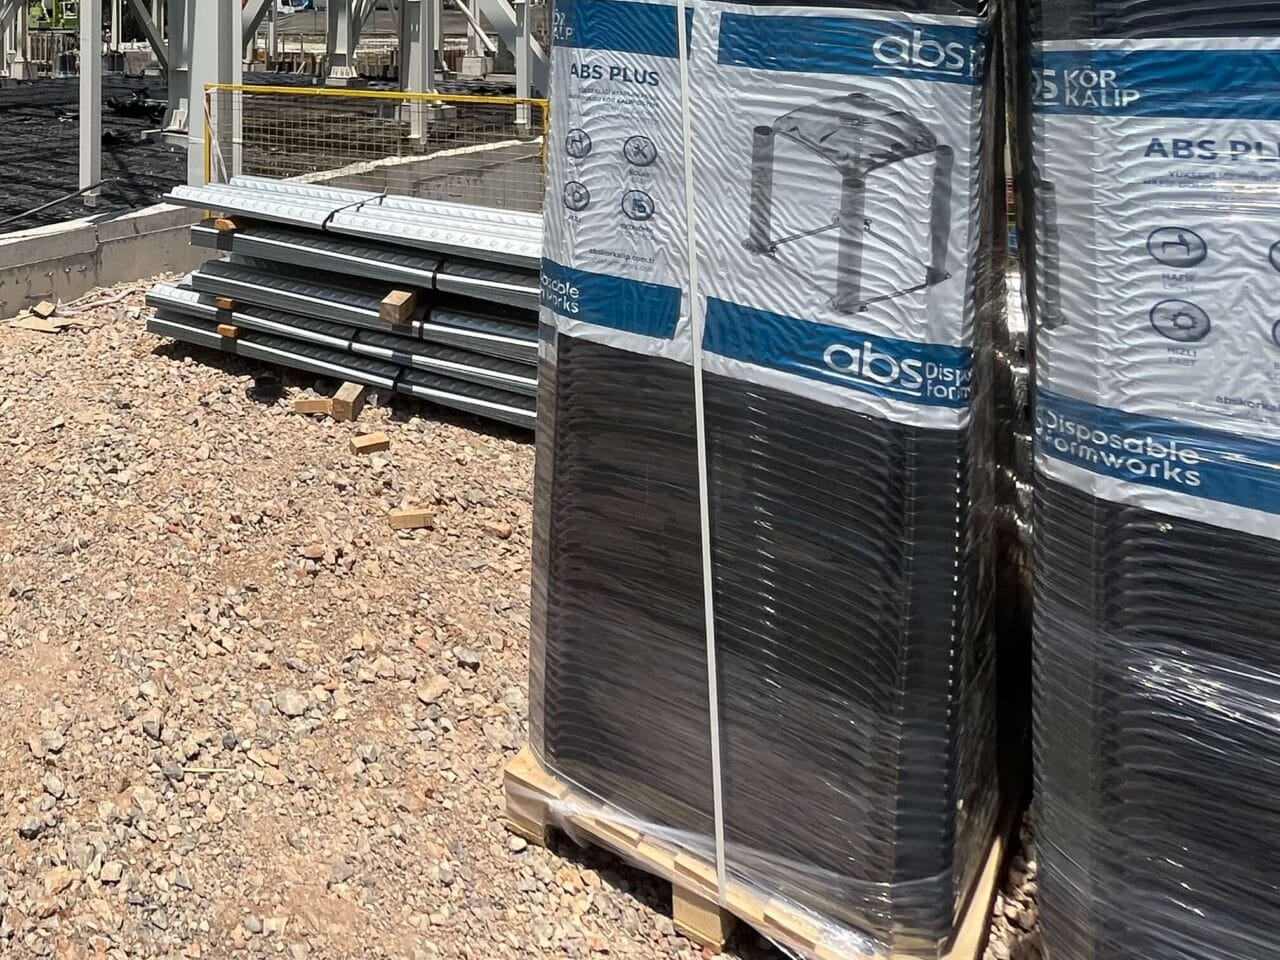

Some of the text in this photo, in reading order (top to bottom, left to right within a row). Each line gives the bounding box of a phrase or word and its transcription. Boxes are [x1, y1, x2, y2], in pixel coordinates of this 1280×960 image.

[872, 29, 964, 70] abs
[570, 63, 660, 87] ABS PLUS
[1063, 65, 1118, 88] KÖR
[1144, 137, 1218, 160] ABS
[822, 341, 923, 389] abs
